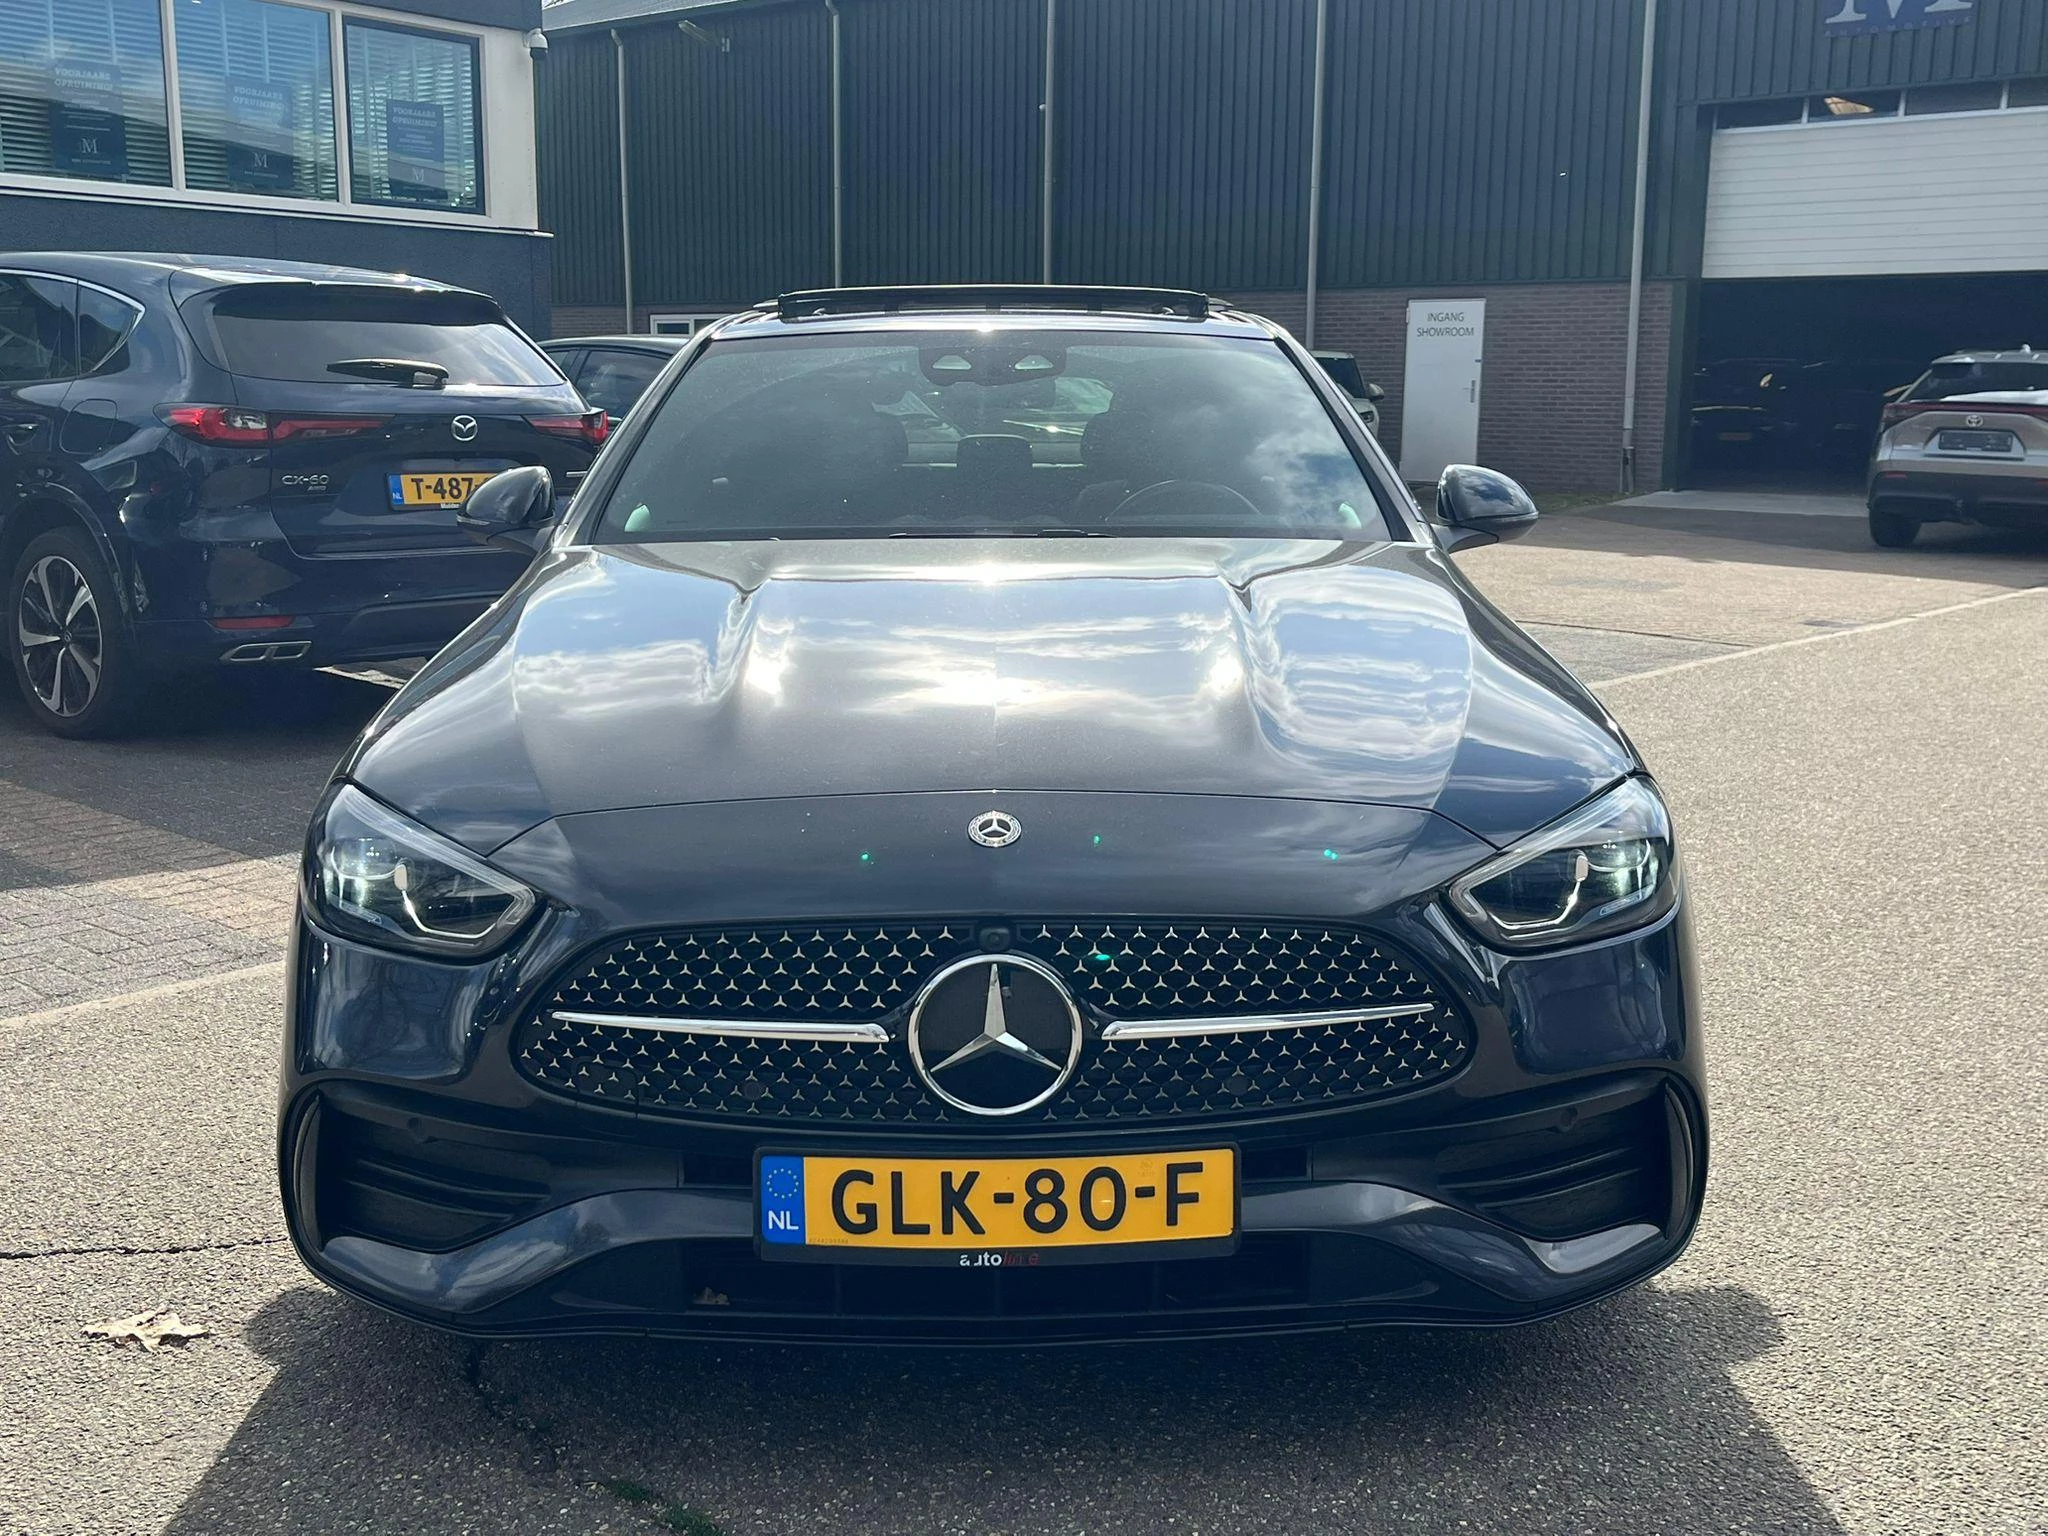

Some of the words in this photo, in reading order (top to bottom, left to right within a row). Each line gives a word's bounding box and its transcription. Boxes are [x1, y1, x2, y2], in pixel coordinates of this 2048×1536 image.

[1427, 312, 1465, 322] INGANG
[1416, 327, 1475, 337] SHOWROOM
[281, 474, 329, 485] CX-60
[830, 1161, 1204, 1236] GLK-80-F
[767, 1210, 799, 1230] NL
